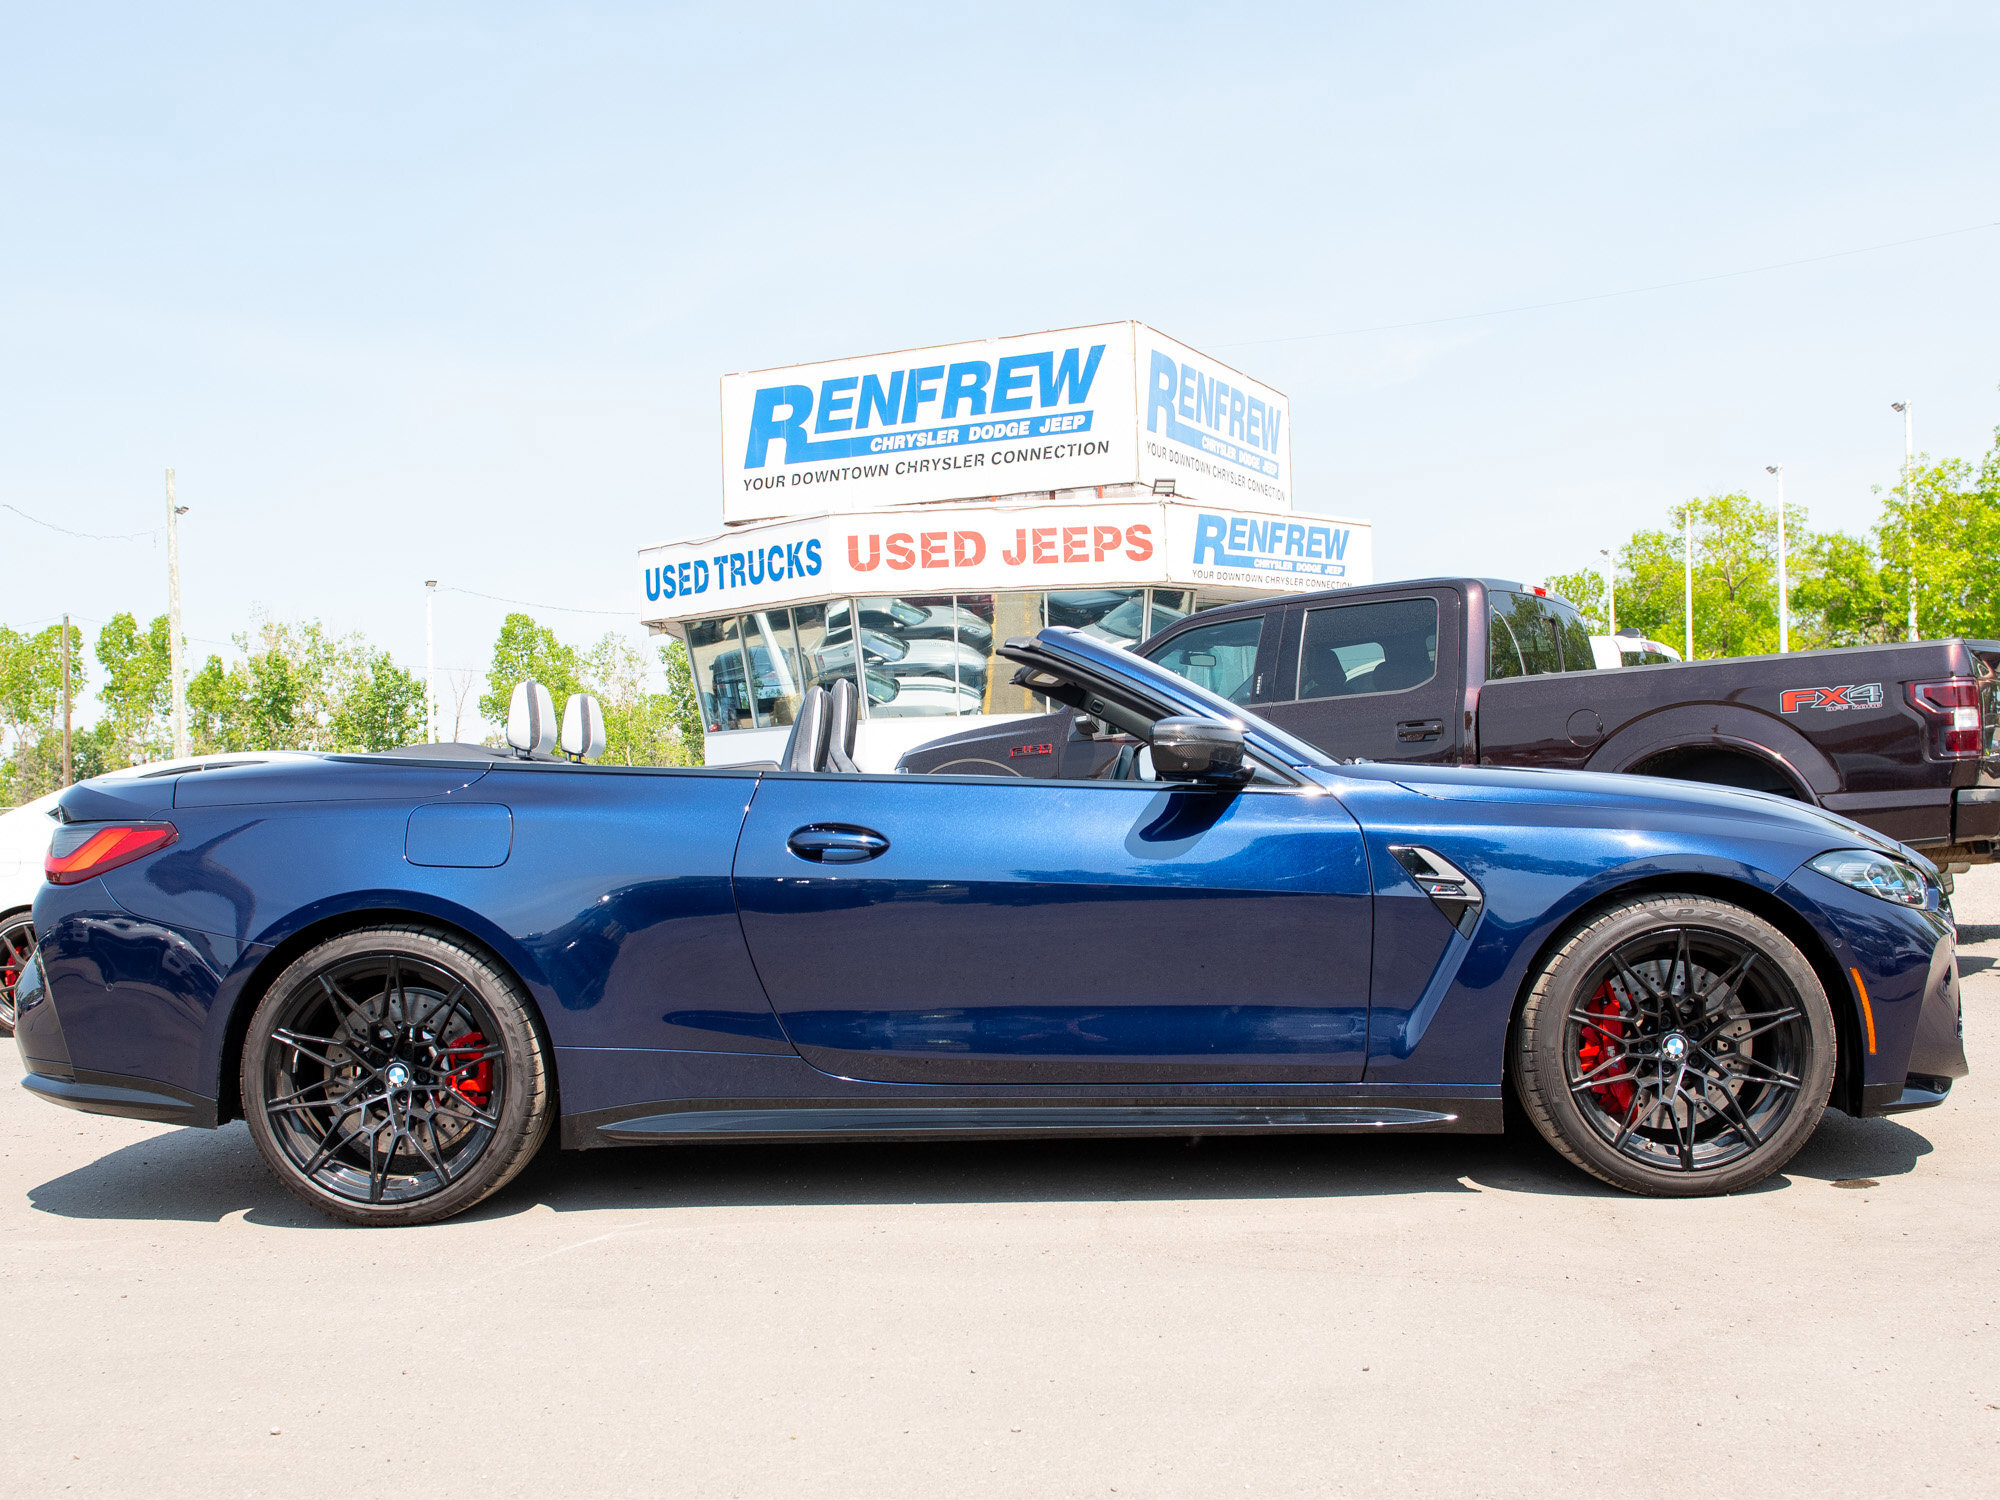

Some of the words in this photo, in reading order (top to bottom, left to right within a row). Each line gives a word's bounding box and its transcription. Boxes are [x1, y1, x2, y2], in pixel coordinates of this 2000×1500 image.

[744, 344, 1106, 469] RENFREW
[1147, 349, 1281, 455] RENFREW
[870, 429, 959, 453] CHRYSLER
[969, 419, 1030, 440] DODGE
[1039, 415, 1086, 434] JEEP
[743, 474, 786, 491] YOUR
[791, 463, 890, 486] DOWNTOWN
[895, 453, 985, 476] CHRYSLER
[991, 440, 1110, 465] CONNECTION
[1146, 441, 1167, 459] YOUR
[1169, 450, 1211, 476] DOWNTOWN
[1212, 465, 1247, 487] CHRYSLER
[1247, 478, 1285, 501] CONNECTION
[847, 530, 986, 572] USED
[1002, 524, 1154, 566] JEEPS
[1193, 513, 1350, 566] RENFREW
[645, 563, 709, 602] USED
[713, 538, 822, 590] TRUCKS
[1192, 569, 1214, 580] YOUR
[1216, 571, 1263, 584] DOWNTOWN
[1265, 575, 1304, 588] CHRYSLER
[1780, 682, 1883, 714] FX4
[1674, 908, 1694, 919] P
[1700, 910, 1782, 951] ZERO
